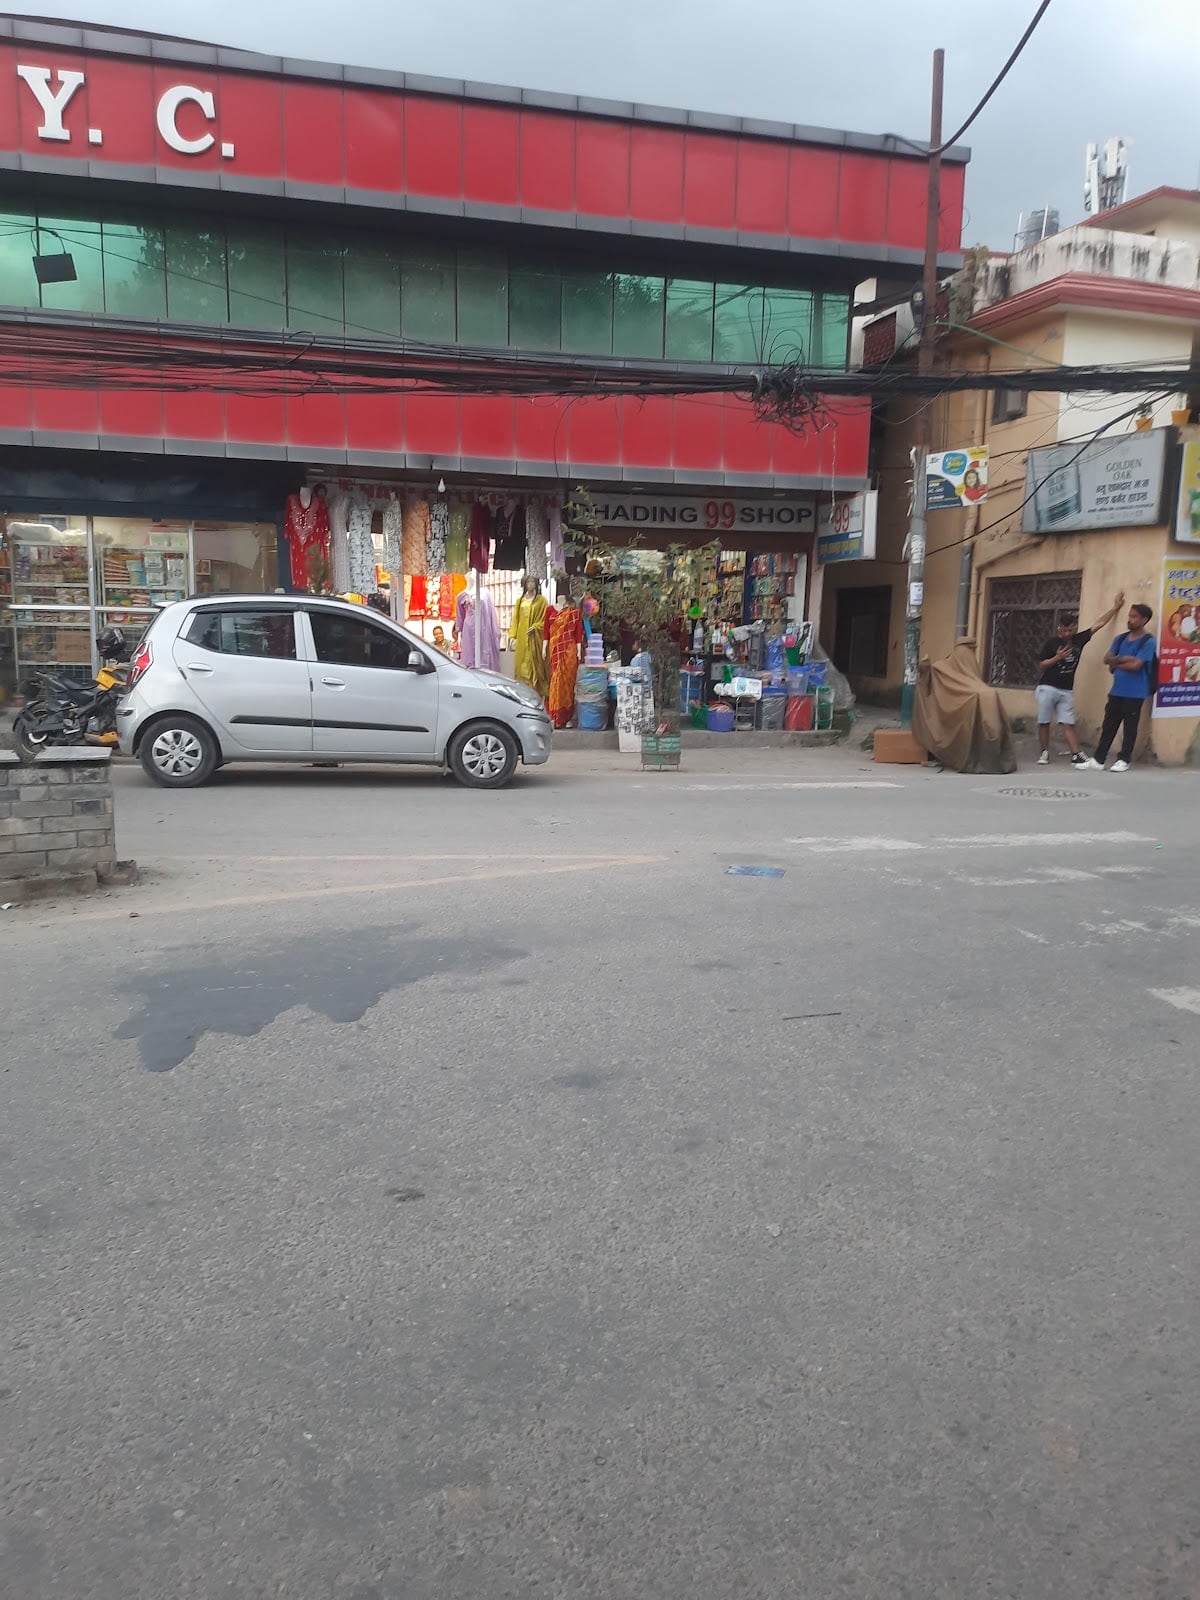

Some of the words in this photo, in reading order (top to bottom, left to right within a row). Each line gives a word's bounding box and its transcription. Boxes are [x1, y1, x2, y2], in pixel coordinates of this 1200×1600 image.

[17, 65, 102, 143] Y.
[157, 85, 235, 157] C.
[1105, 458, 1143, 472] GOLDEN
[1113, 470, 1132, 481] OAK
[704, 500, 737, 529] 99
[739, 506, 813, 524] SHOP
[834, 501, 850, 533] 99
